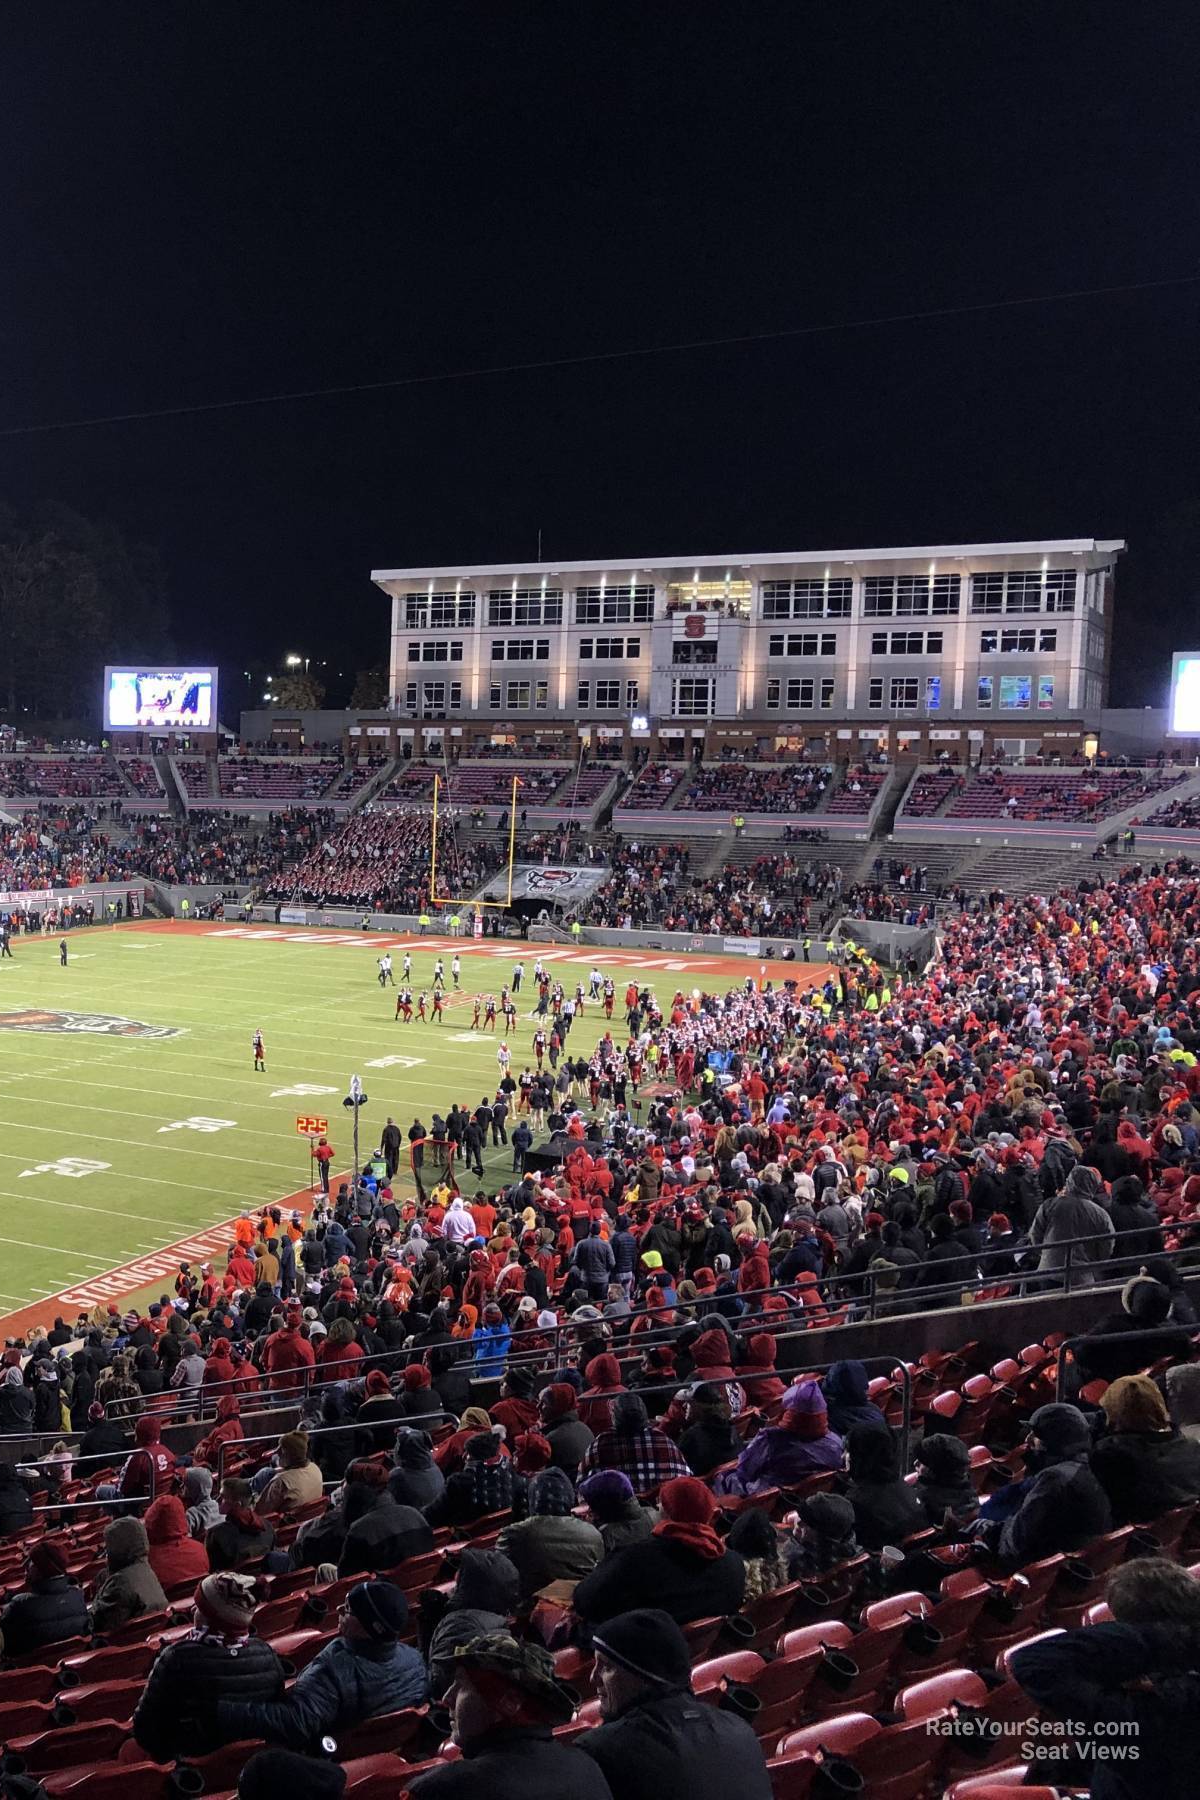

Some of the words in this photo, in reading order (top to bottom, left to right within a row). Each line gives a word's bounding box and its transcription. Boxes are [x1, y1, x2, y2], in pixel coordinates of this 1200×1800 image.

[201, 928, 722, 970] WOLFPACK
[169, 1116, 238, 1132] 30
[297, 1117, 327, 1134] 225
[34, 1157, 112, 1178] 20
[58, 1253, 193, 1308] STRENGTH
[171, 1242, 218, 1258] IN
